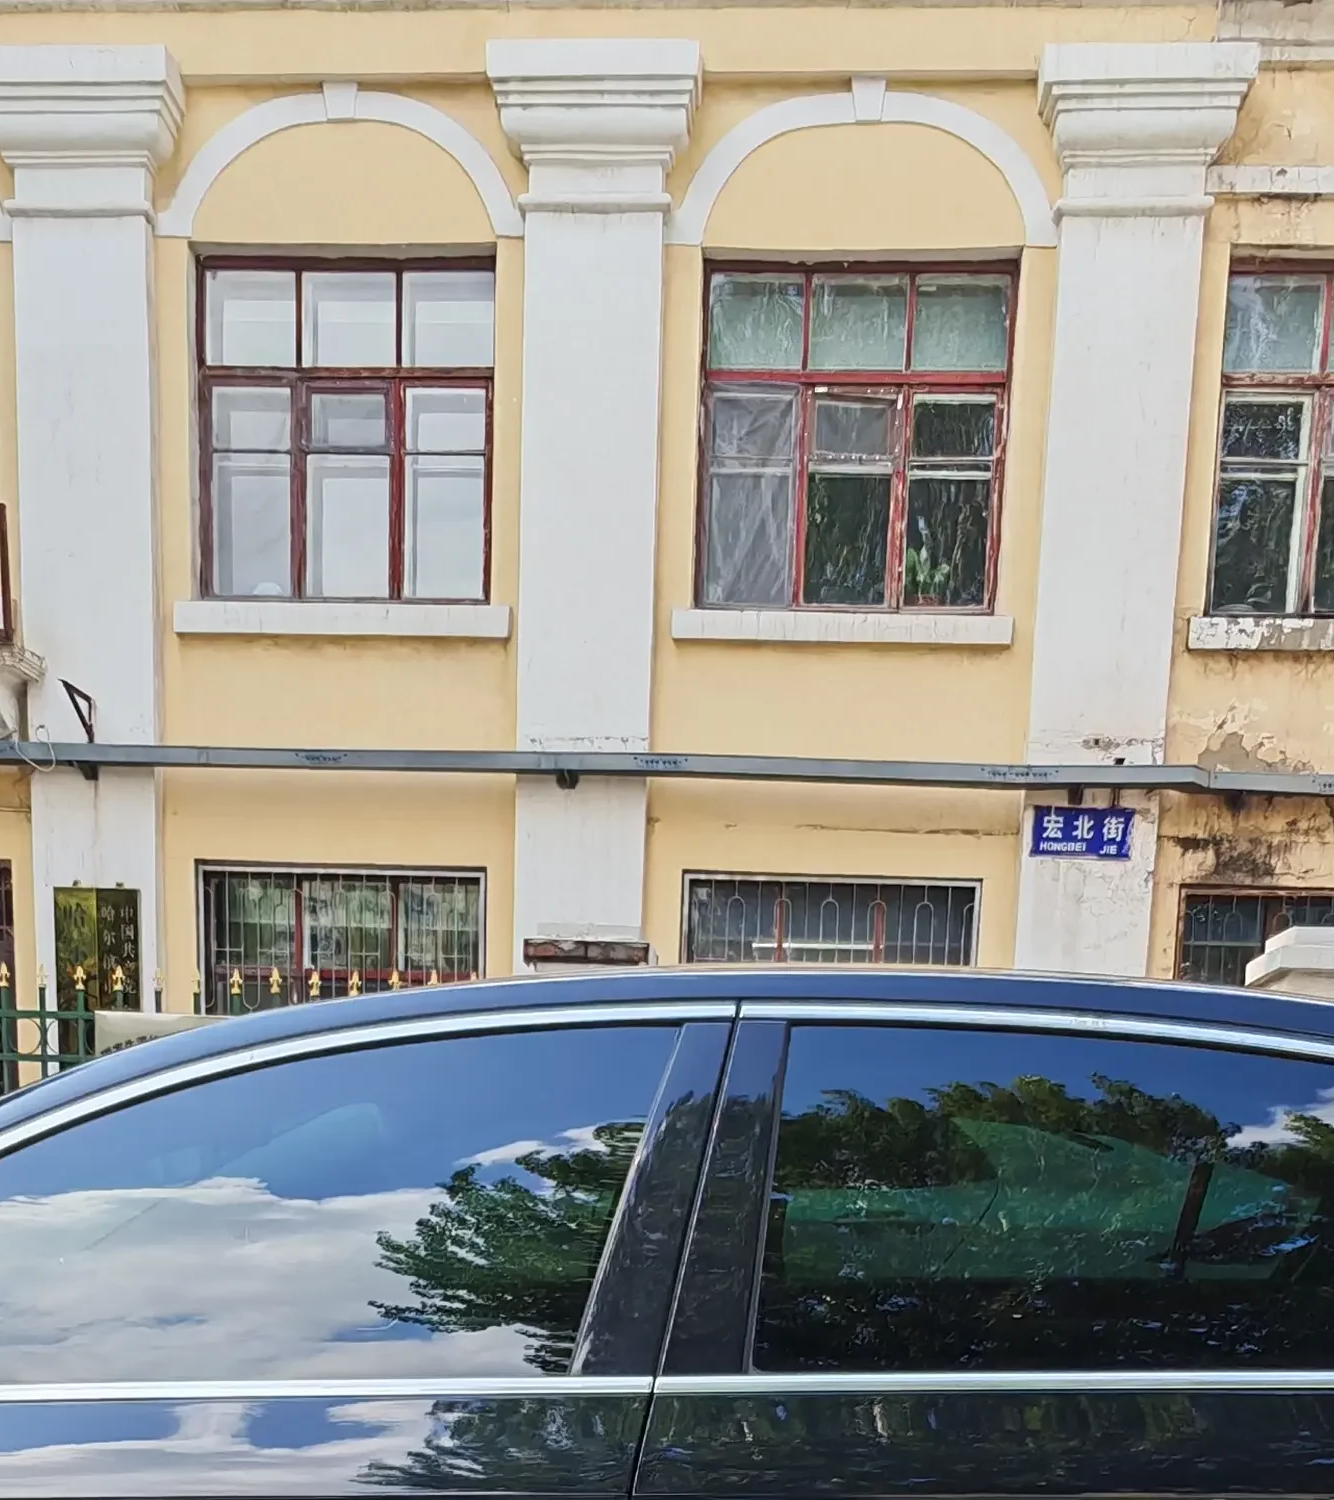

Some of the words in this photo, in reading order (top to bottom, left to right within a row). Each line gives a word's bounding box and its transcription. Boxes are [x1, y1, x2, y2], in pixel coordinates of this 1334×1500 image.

[1042, 814, 1125, 842] 宏北街
[1039, 841, 1086, 852] HONGBEI
[1099, 845, 1117, 855] JIE
